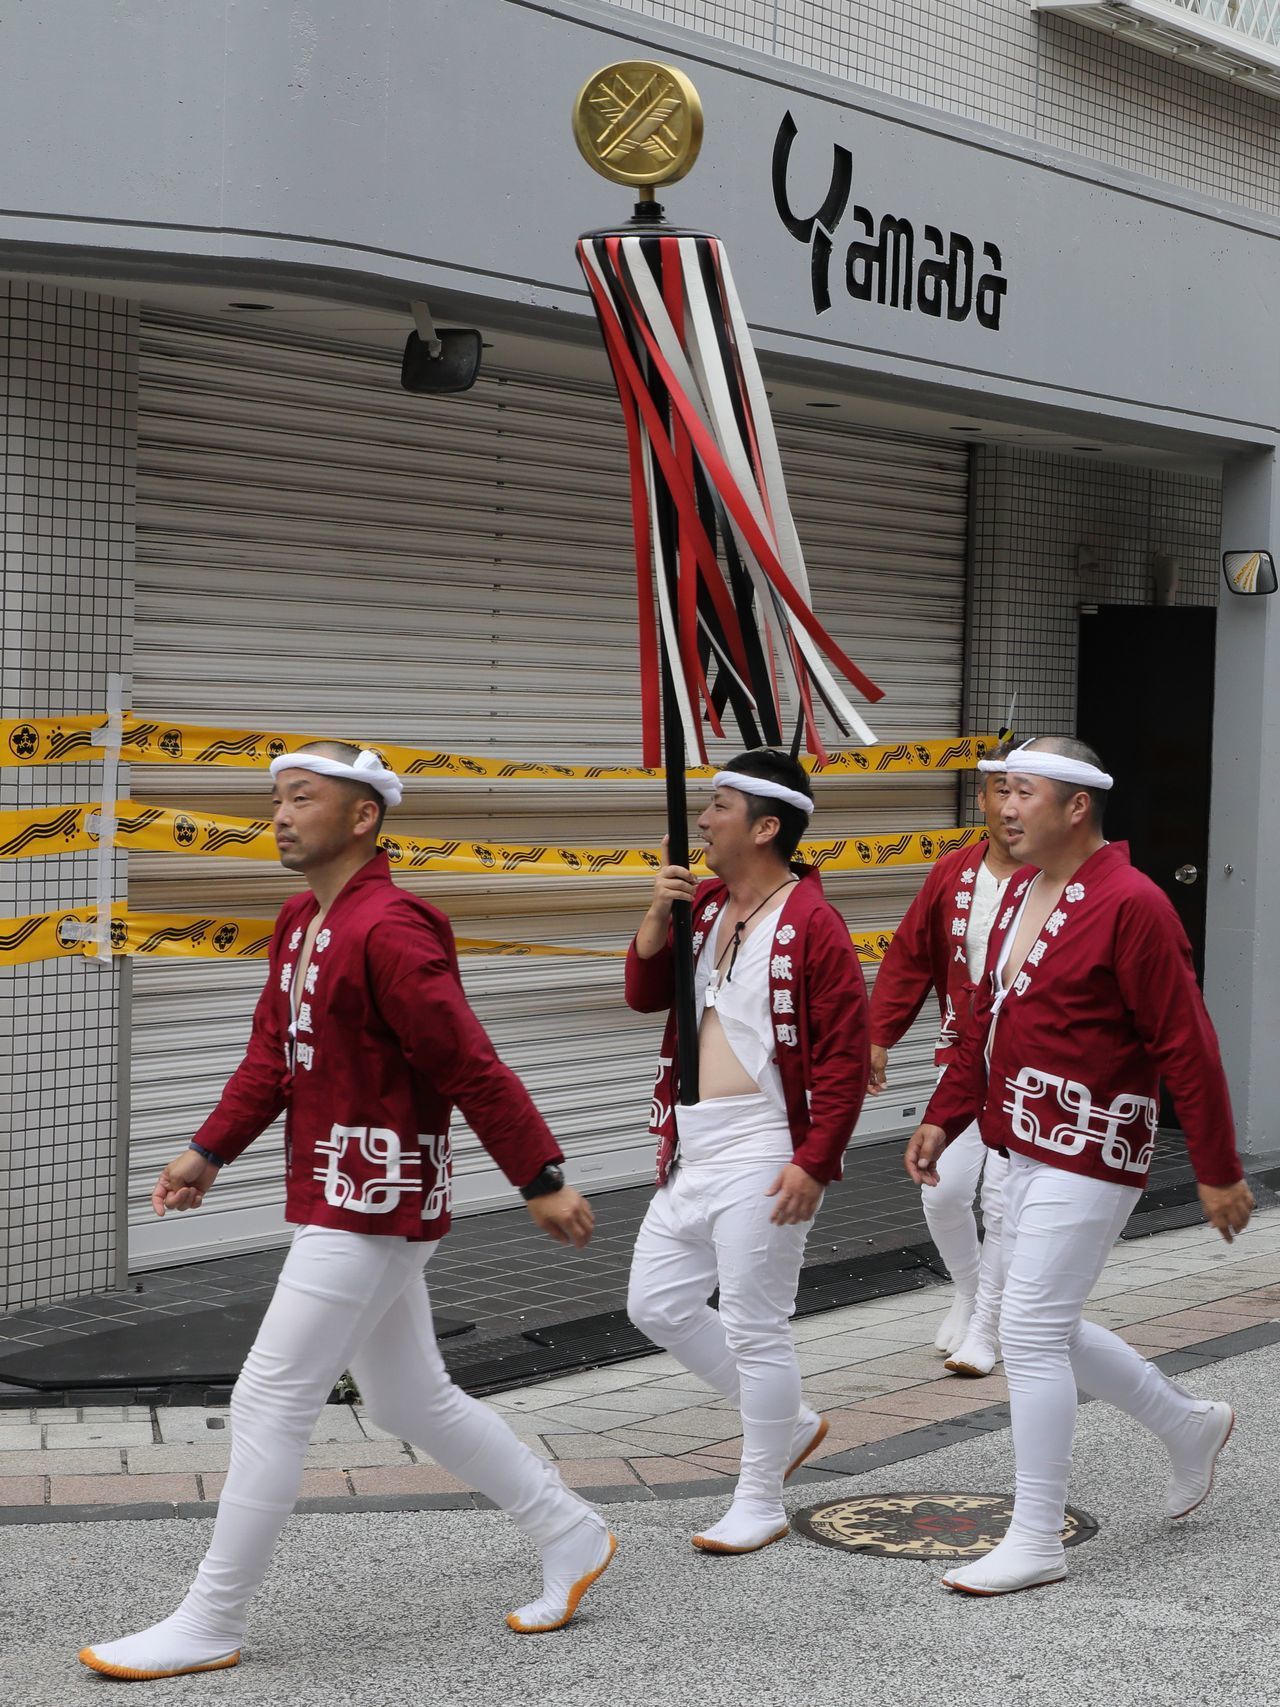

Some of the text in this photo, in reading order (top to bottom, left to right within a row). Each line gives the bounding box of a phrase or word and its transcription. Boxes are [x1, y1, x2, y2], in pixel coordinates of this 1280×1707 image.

[951, 891, 973, 964] 世話人
[1012, 908, 1068, 997] 紙屋町
[296, 962, 320, 1072] 紙屋町
[769, 954, 798, 1048] 紙屋町
